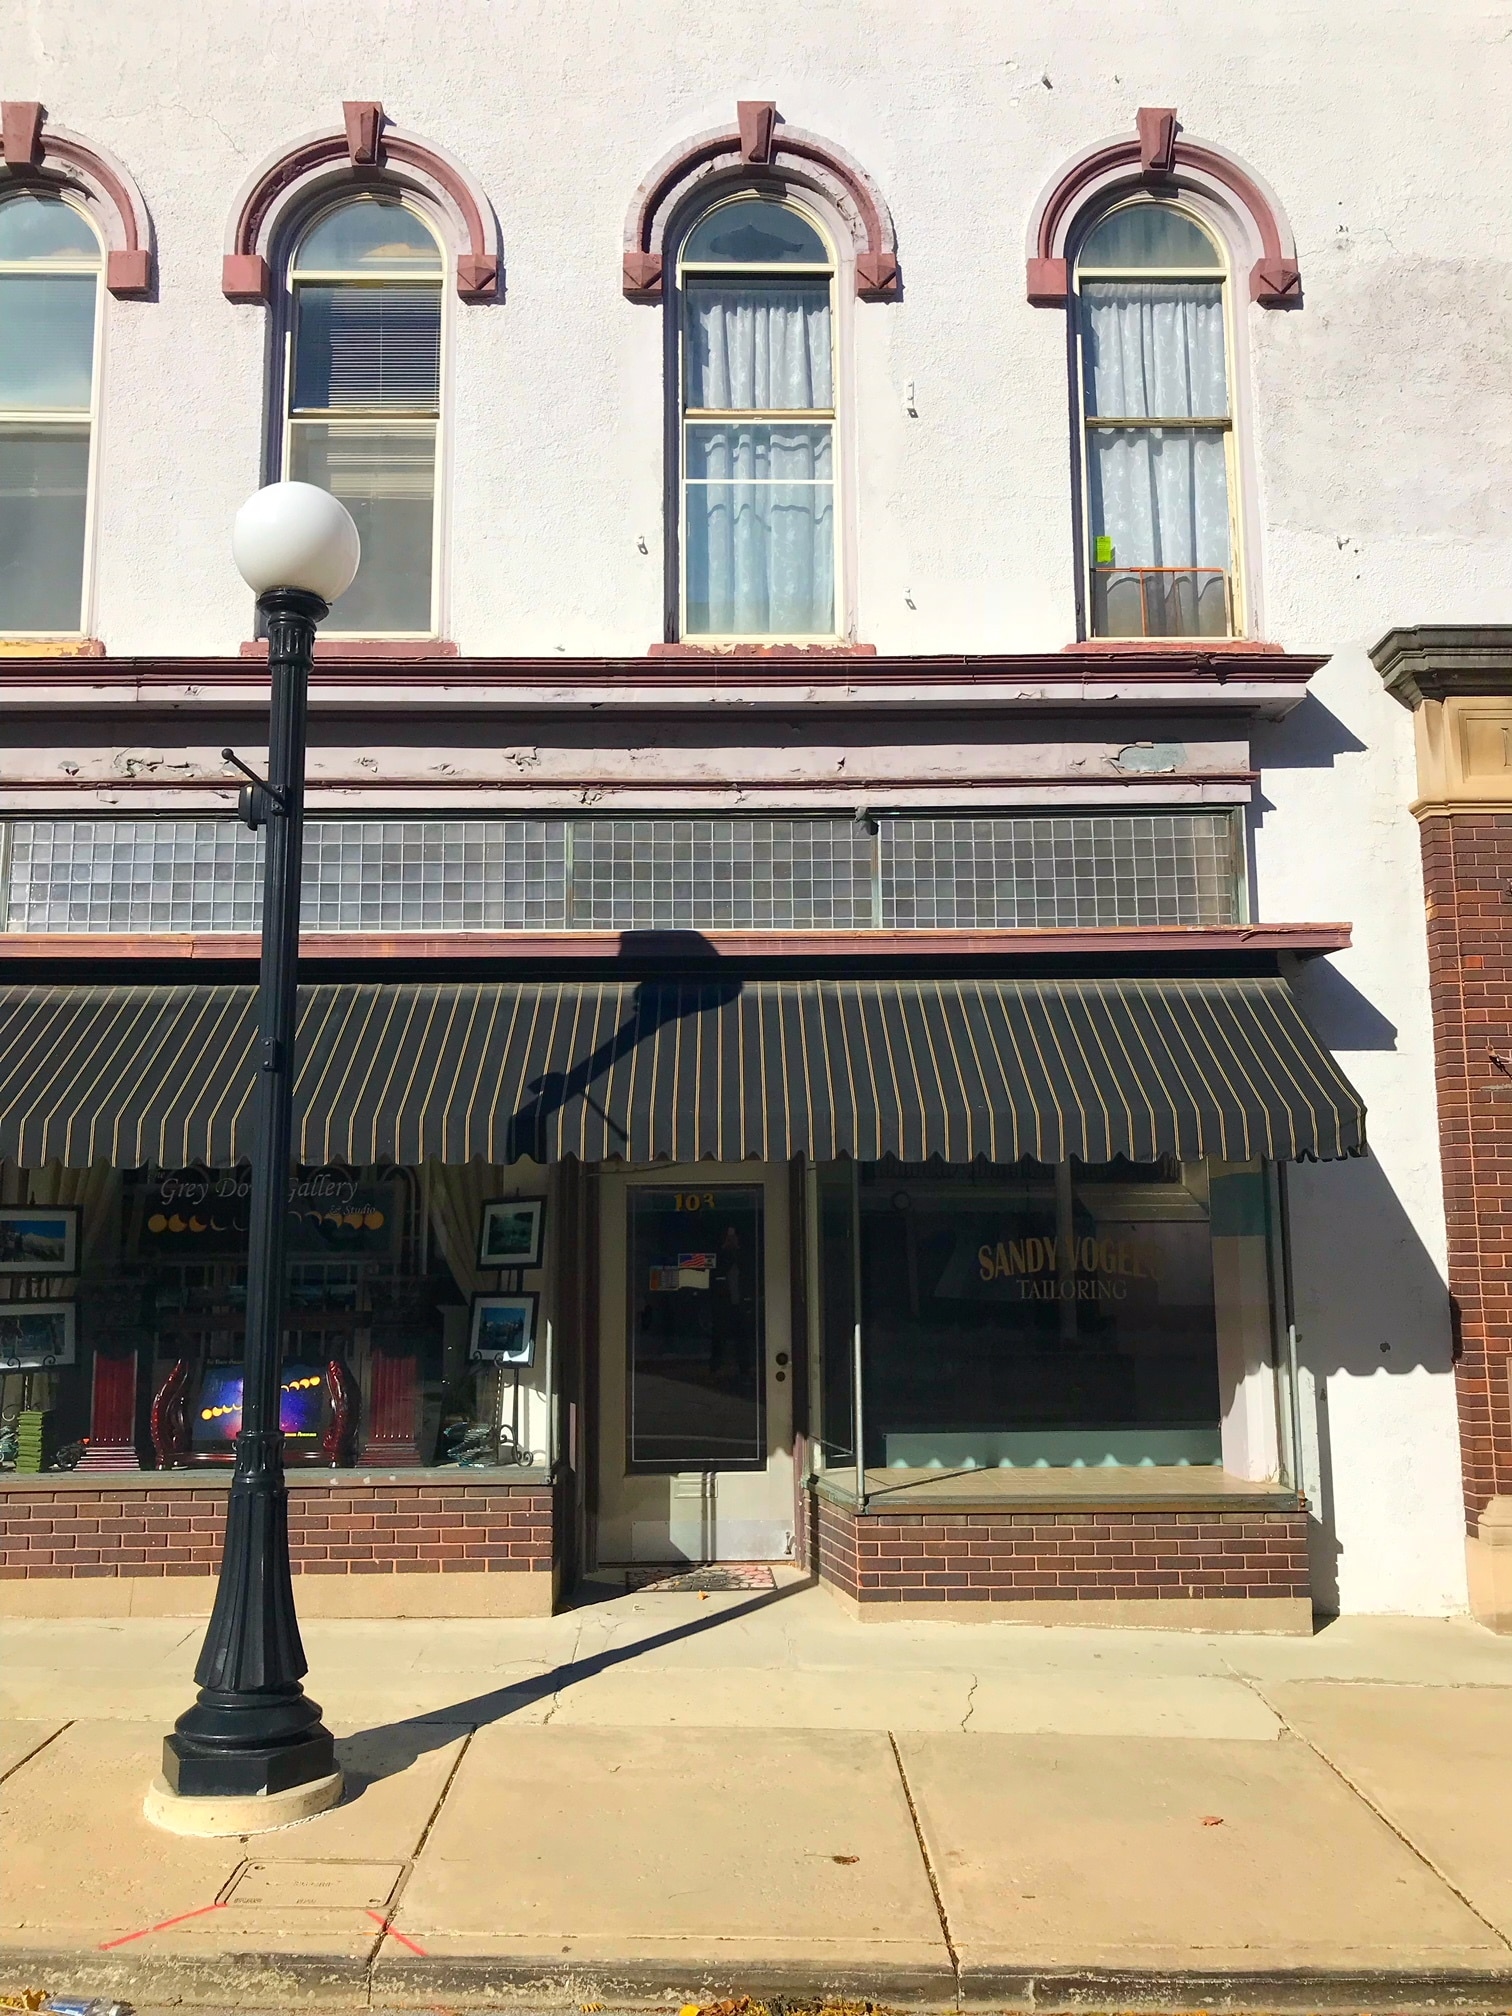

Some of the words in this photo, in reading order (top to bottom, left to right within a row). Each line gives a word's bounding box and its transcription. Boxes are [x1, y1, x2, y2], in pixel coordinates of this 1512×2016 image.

[160, 1177, 209, 1206] Grey
[673, 1192, 716, 1212] 103
[343, 1202, 376, 1215] Studio
[978, 1236, 1058, 1281] SANDY
[1016, 1279, 1128, 1300] TAILORING
